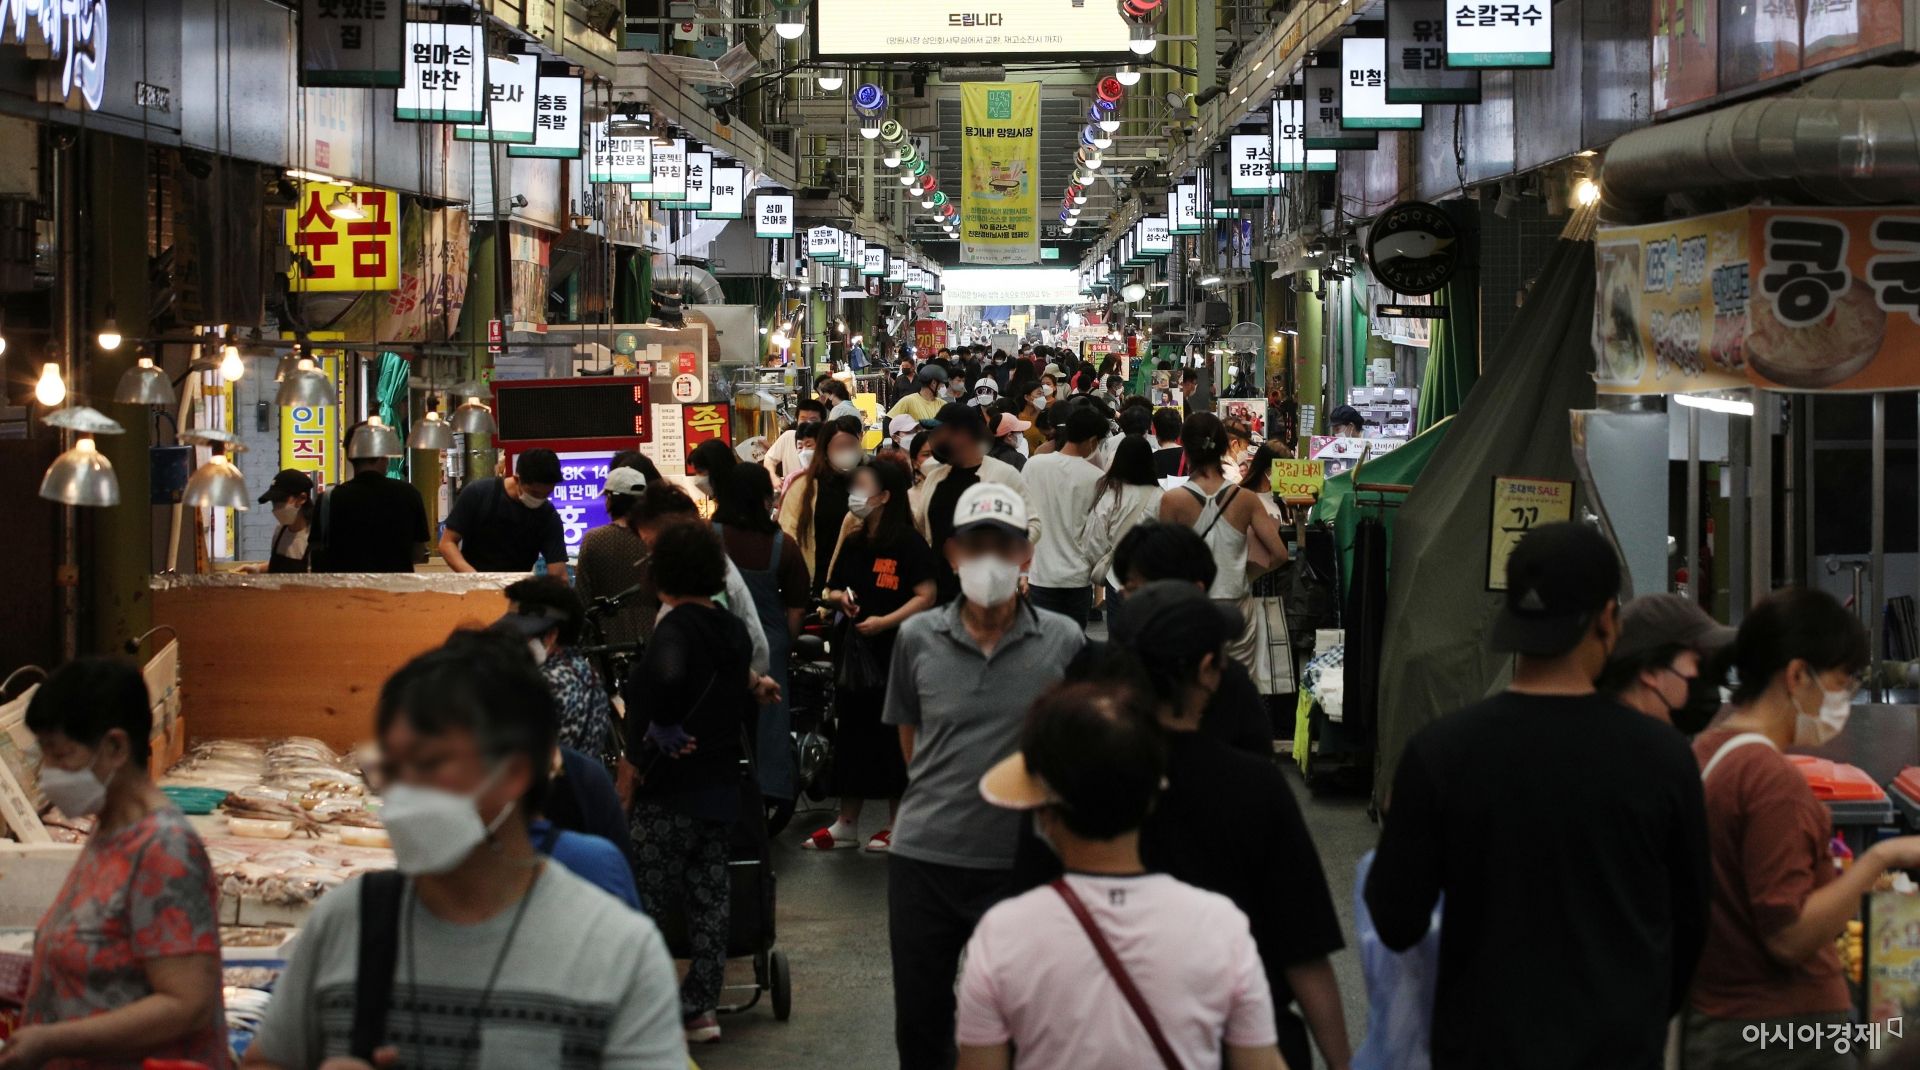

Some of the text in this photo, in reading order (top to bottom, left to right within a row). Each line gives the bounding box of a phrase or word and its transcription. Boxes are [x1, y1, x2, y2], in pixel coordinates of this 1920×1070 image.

[948, 13, 1003, 27] 드립니다
[1456, 5, 1542, 27] 손칼국수
[341, 25, 361, 49] 집
[413, 43, 472, 66] 엄마손
[421, 70, 460, 91] 반찬
[1350, 70, 1386, 87] 민철
[489, 83, 524, 103] 보사
[538, 95, 567, 112] 충동
[538, 114, 567, 131] 족발
[965, 127, 1033, 138] 용기내! 망원시장
[597, 139, 645, 153] 대원어묵
[652, 153, 682, 163] 프로젝트
[652, 165, 681, 178] 무침
[1240, 163, 1275, 177] 닭강정
[766, 204, 783, 214] 성미
[761, 215, 787, 225] 건어물
[1388, 210, 1443, 230] GOOSE
[294, 191, 391, 279] 순금
[865, 254, 880, 262] BYC
[1387, 265, 1446, 287] ISLAND
[687, 405, 727, 440] 족
[292, 406, 326, 493] 인직
[562, 465, 609, 480] 8K 14
[548, 484, 598, 501] 매판매
[1536, 486, 1560, 497] SALE
